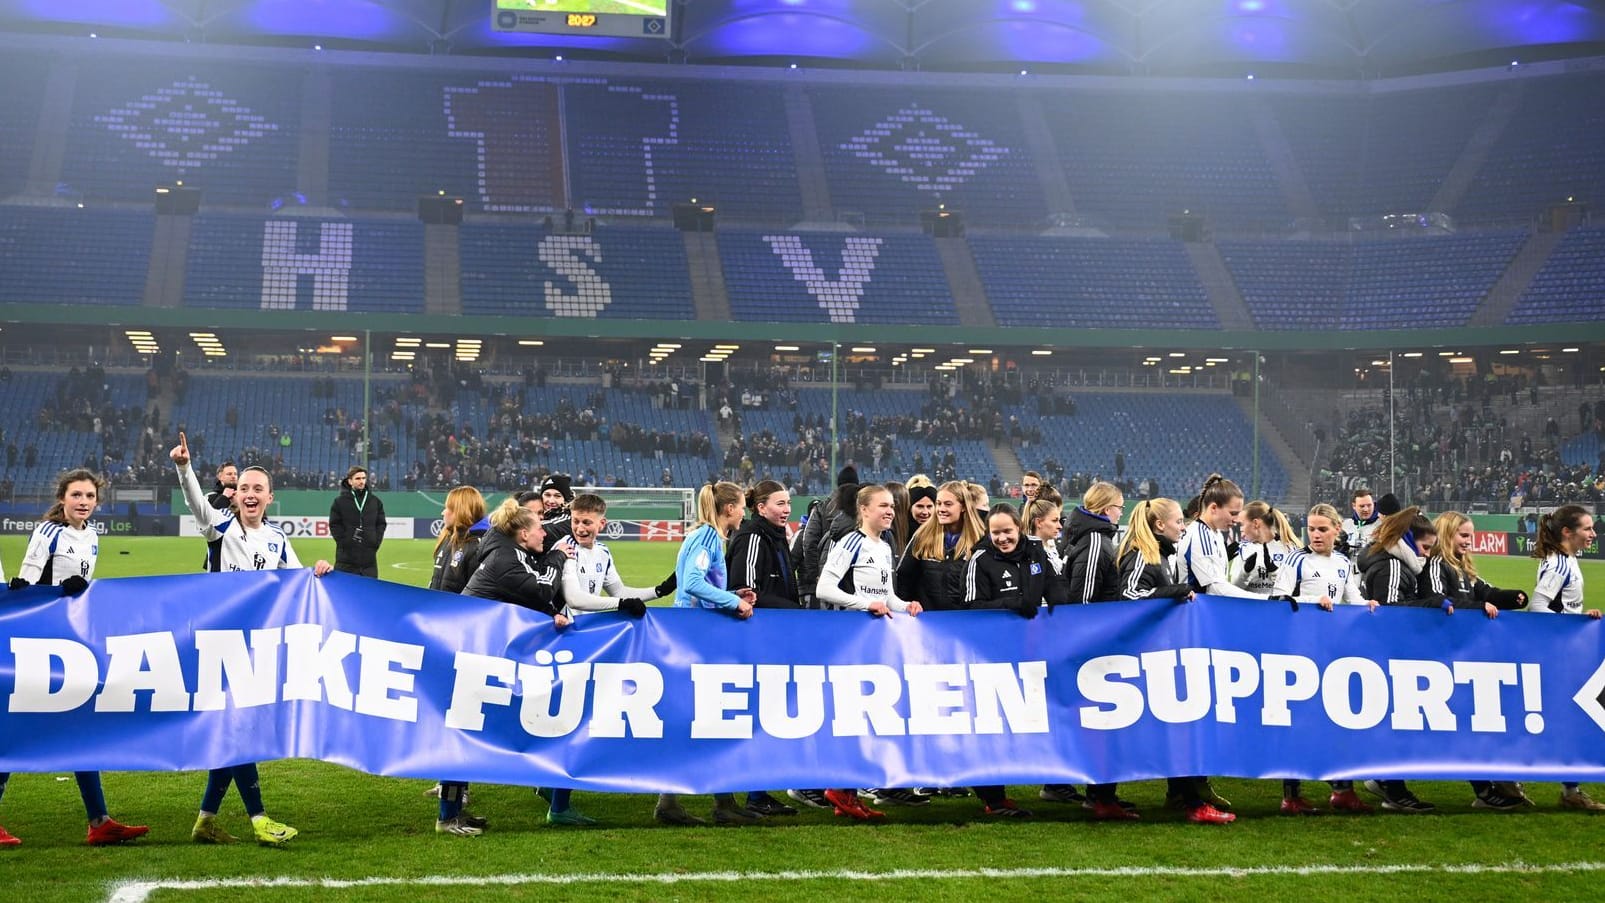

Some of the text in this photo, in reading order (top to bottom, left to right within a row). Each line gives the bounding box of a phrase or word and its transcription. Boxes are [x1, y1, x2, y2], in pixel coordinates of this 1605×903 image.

[1466, 533, 1506, 553] LARM
[8, 624, 1545, 739] DANKE FÜR EUREN SUPPORT!
